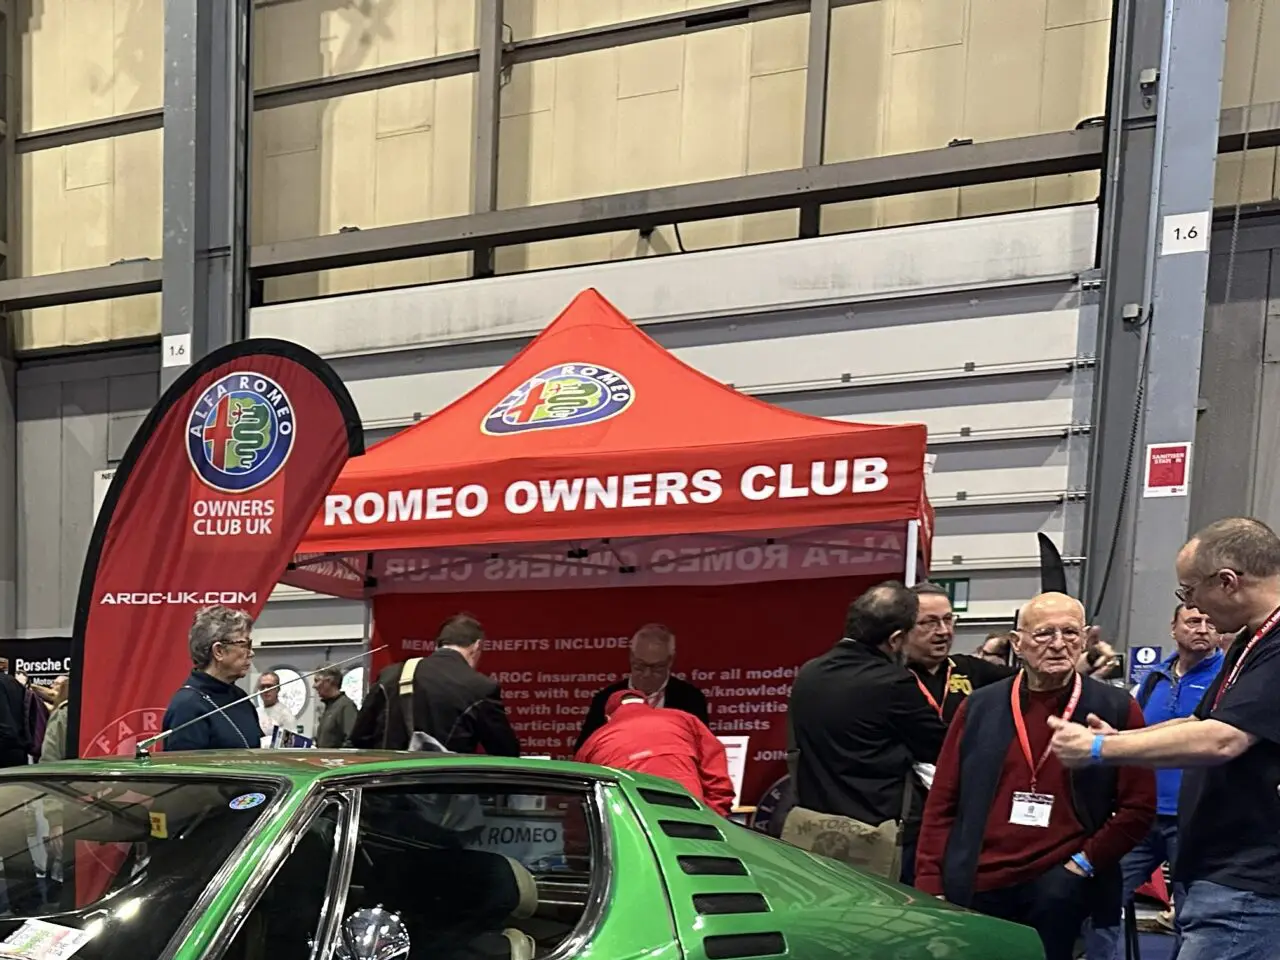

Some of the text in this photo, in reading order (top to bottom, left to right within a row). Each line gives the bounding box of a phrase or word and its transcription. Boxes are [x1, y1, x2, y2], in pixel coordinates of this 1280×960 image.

[1173, 226, 1198, 240] 1.6
[170, 345, 185, 356] 1.6
[560, 365, 630, 402] ROMEO
[190, 376, 292, 438] ALFA ROMEO
[324, 456, 890, 526] ROMEO OWNERS CLUB
[193, 499, 275, 517] OWNERS
[193, 518, 273, 536] CLUB UK
[100, 591, 257, 605] AROC-UK.COM
[483, 638, 550, 651] ENEFITS
[15, 657, 62, 672] Porsche
[490, 672, 533, 683] AROC
[537, 671, 617, 683] insurance
[691, 668, 715, 681] for
[719, 668, 741, 681] all
[534, 688, 566, 700] with
[516, 704, 552, 716] with
[717, 701, 789, 714] activitie
[487, 827, 557, 845] ROMEO
